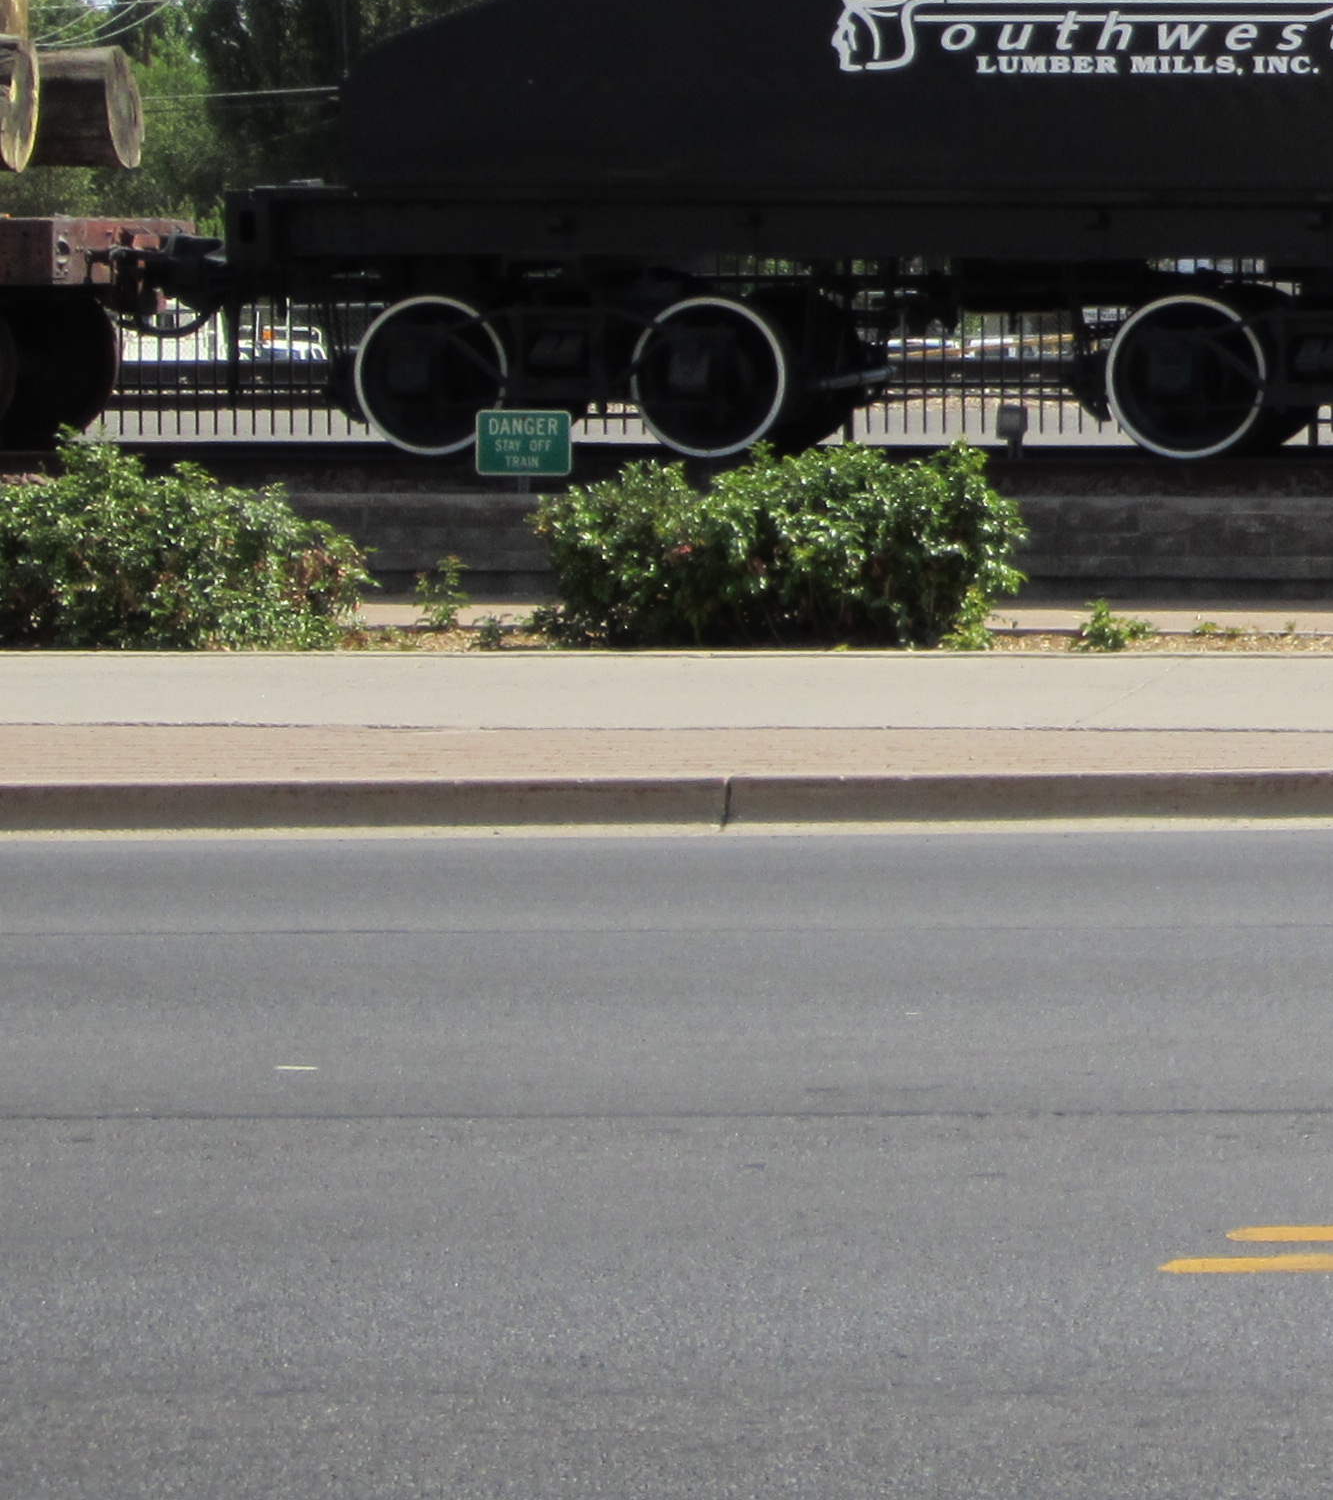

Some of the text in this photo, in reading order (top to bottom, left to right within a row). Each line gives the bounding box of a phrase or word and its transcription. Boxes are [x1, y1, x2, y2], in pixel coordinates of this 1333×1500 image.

[976, 55, 1320, 76] LUMBER MILLS, INC.
[488, 418, 559, 436] DANGER
[494, 439, 552, 452] STAY OFF
[504, 455, 540, 468] TRAIN
